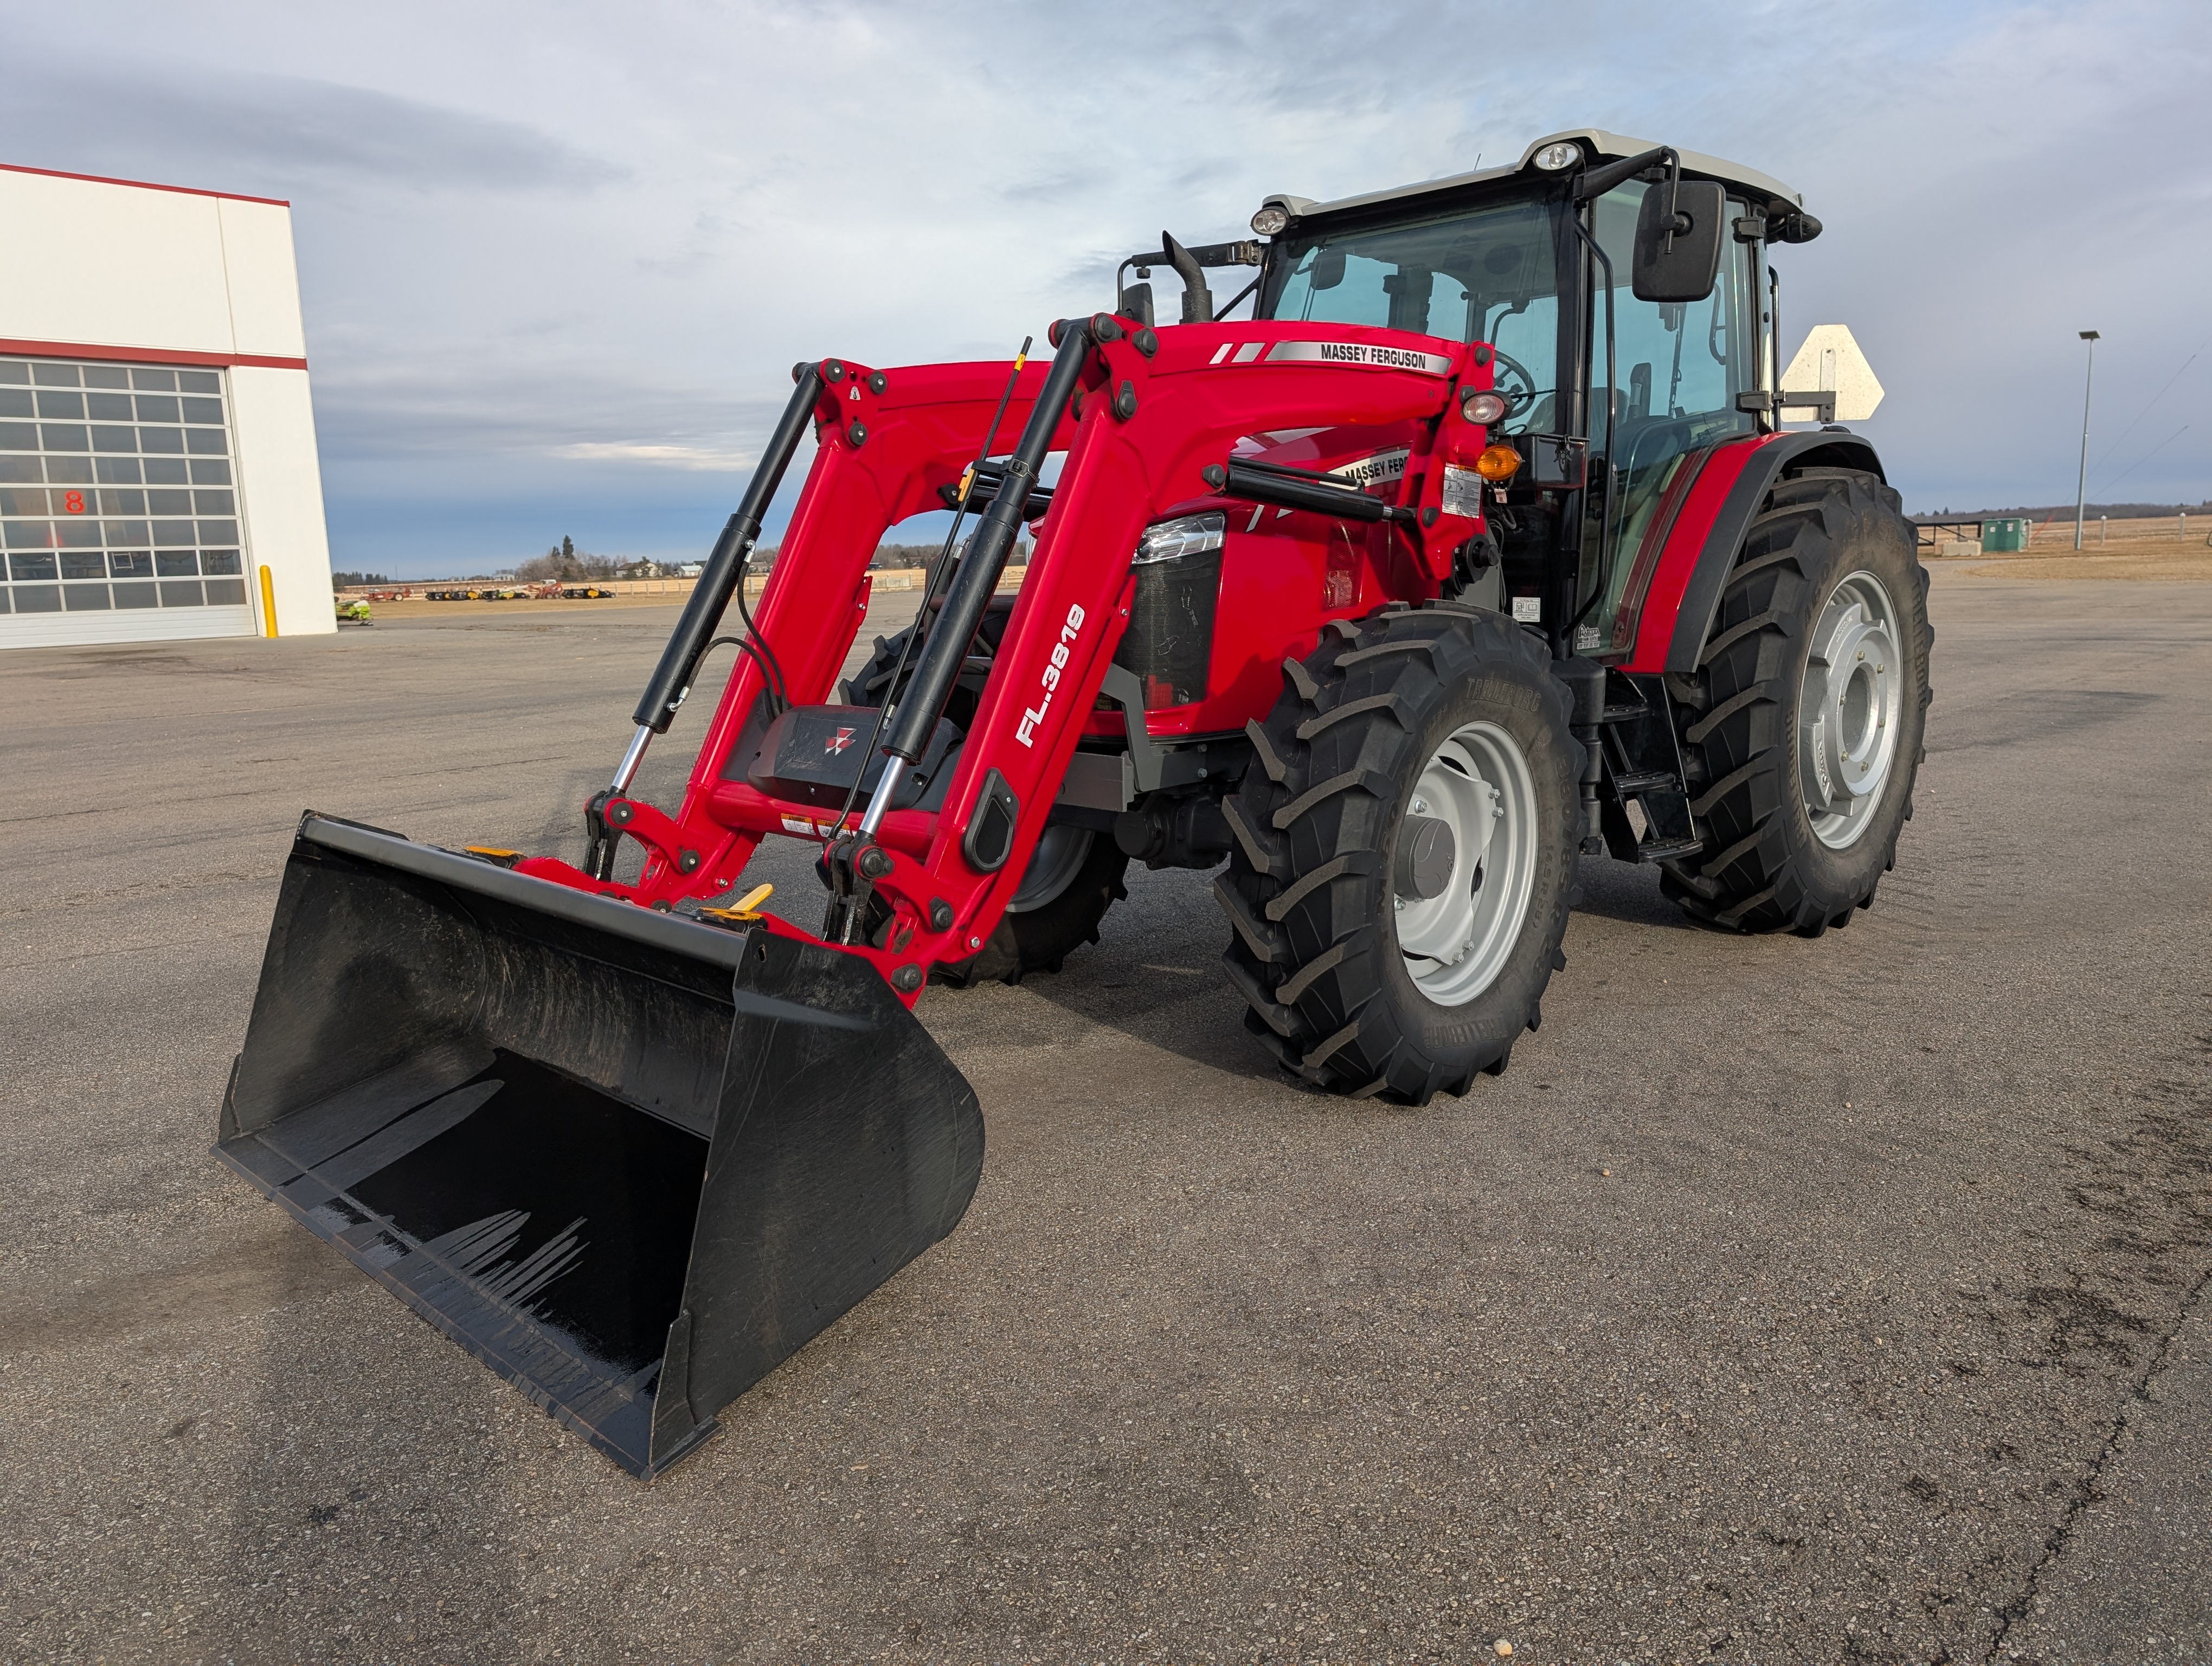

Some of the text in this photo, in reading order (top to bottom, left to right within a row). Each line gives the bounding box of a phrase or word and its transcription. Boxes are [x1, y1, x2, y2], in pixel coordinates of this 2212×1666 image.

[1321, 344, 1426, 369] MASSEY FERGUSON
[65, 490, 85, 514] 8
[1912, 577, 1927, 713] TRELLEBORG
[1015, 604, 1085, 748] FL.3819
[1465, 677, 1541, 713] TRELLEBORG
